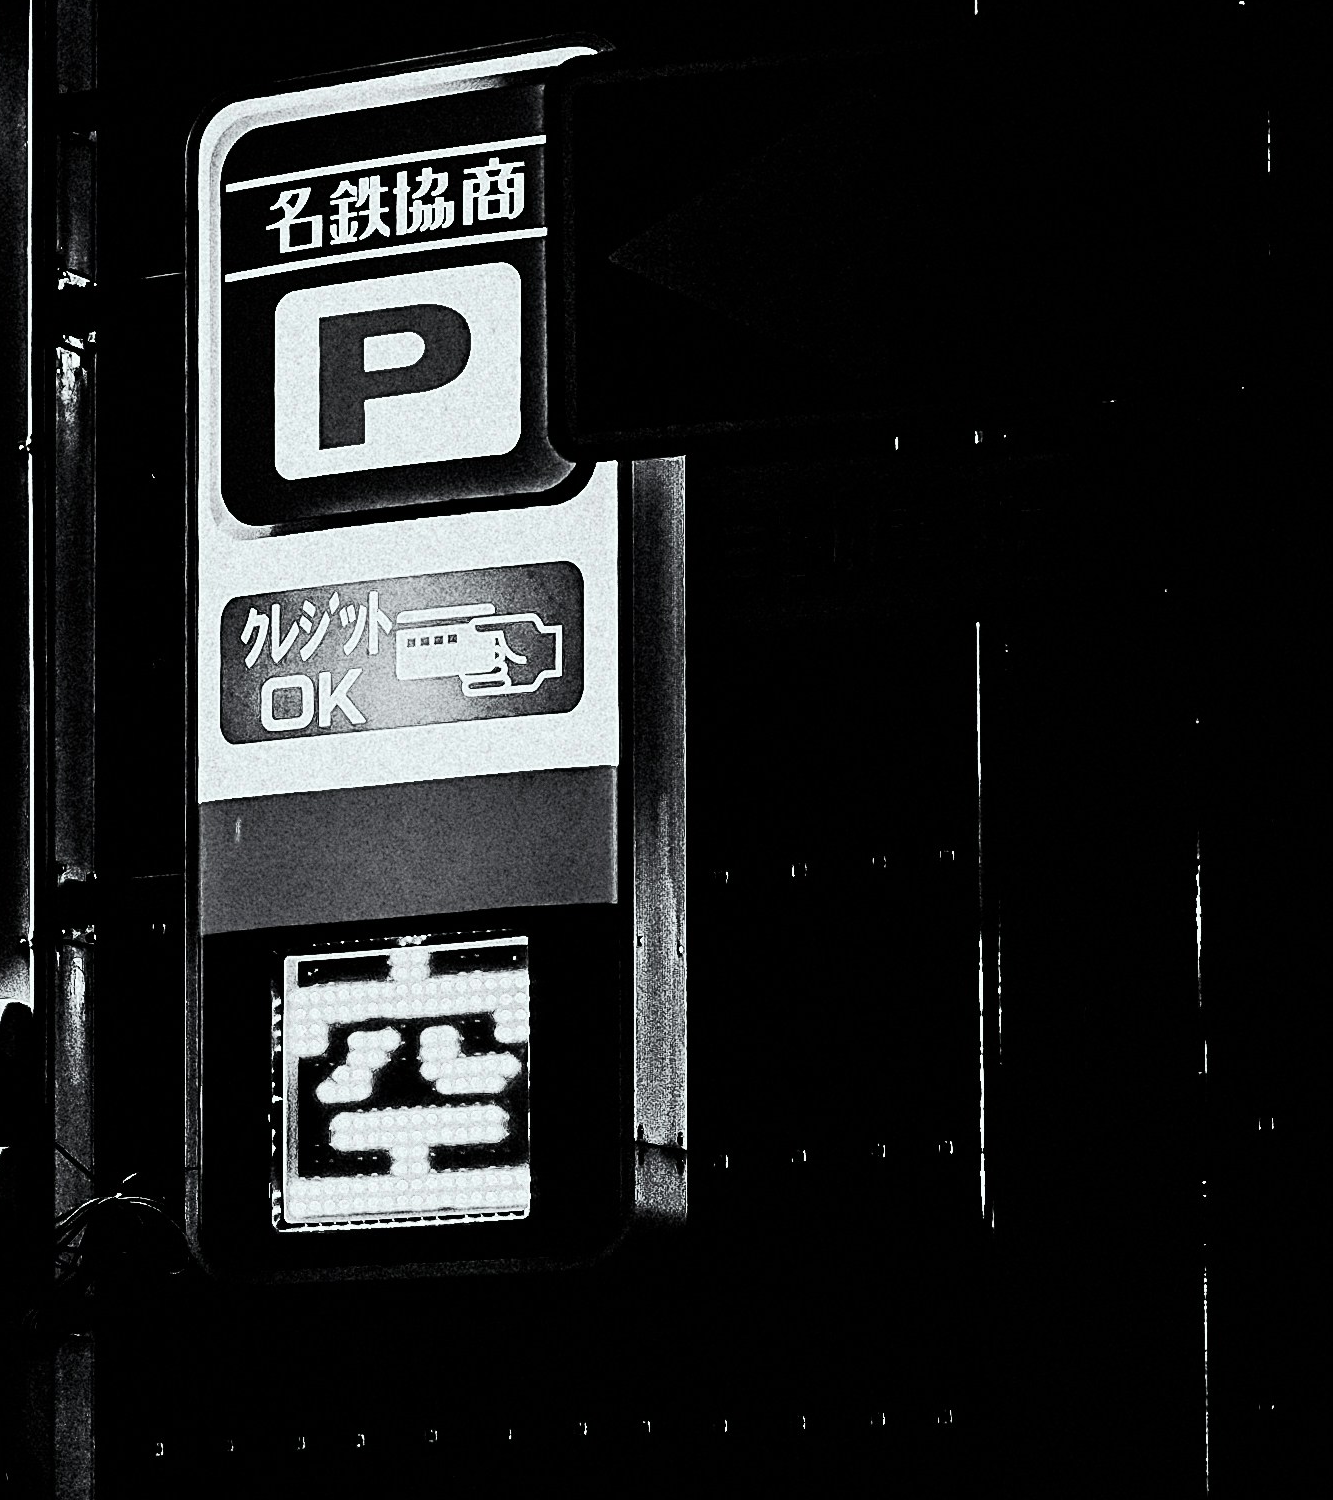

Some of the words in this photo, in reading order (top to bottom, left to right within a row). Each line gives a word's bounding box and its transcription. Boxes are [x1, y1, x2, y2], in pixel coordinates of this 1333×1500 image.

[264, 156, 528, 254] 名鉄協商
[318, 303, 471, 451] P
[240, 590, 393, 669] クレジット
[261, 668, 367, 732] OK
[284, 937, 530, 1225] 空
